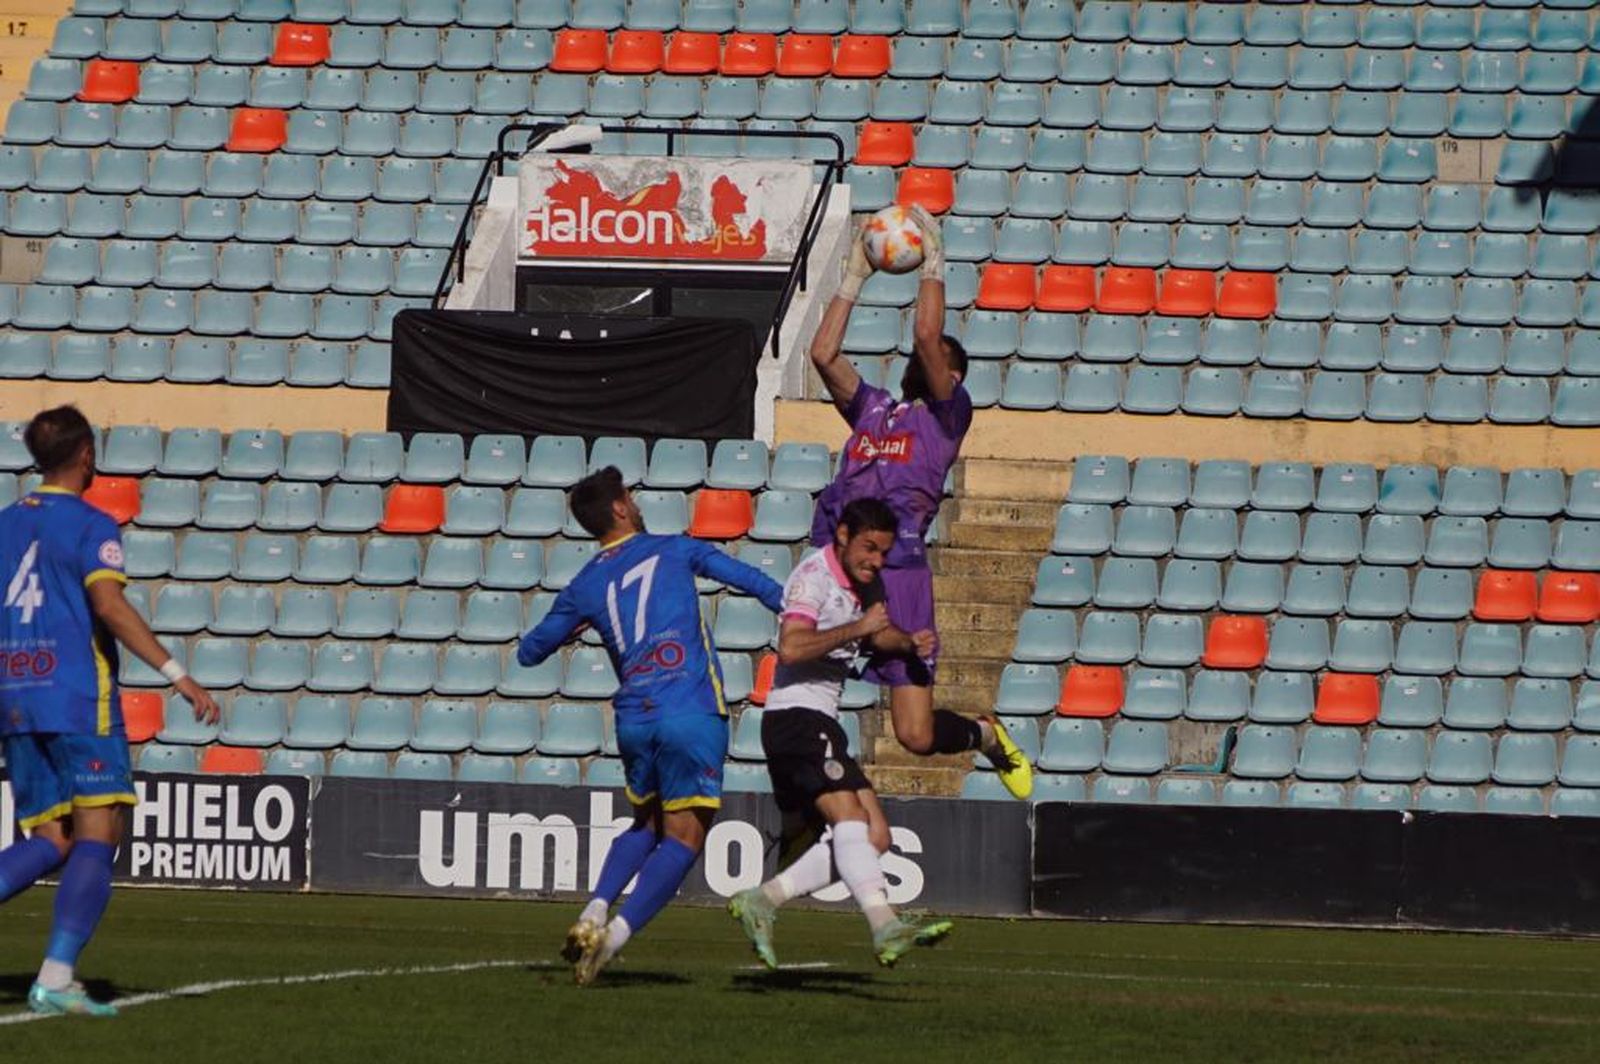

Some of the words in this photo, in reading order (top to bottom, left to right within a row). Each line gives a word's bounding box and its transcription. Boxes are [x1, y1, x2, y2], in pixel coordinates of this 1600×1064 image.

[4, 540, 44, 624] 4
[607, 555, 660, 653] 17
[132, 781, 294, 842] HIELO
[131, 842, 291, 882] PREMIUM
